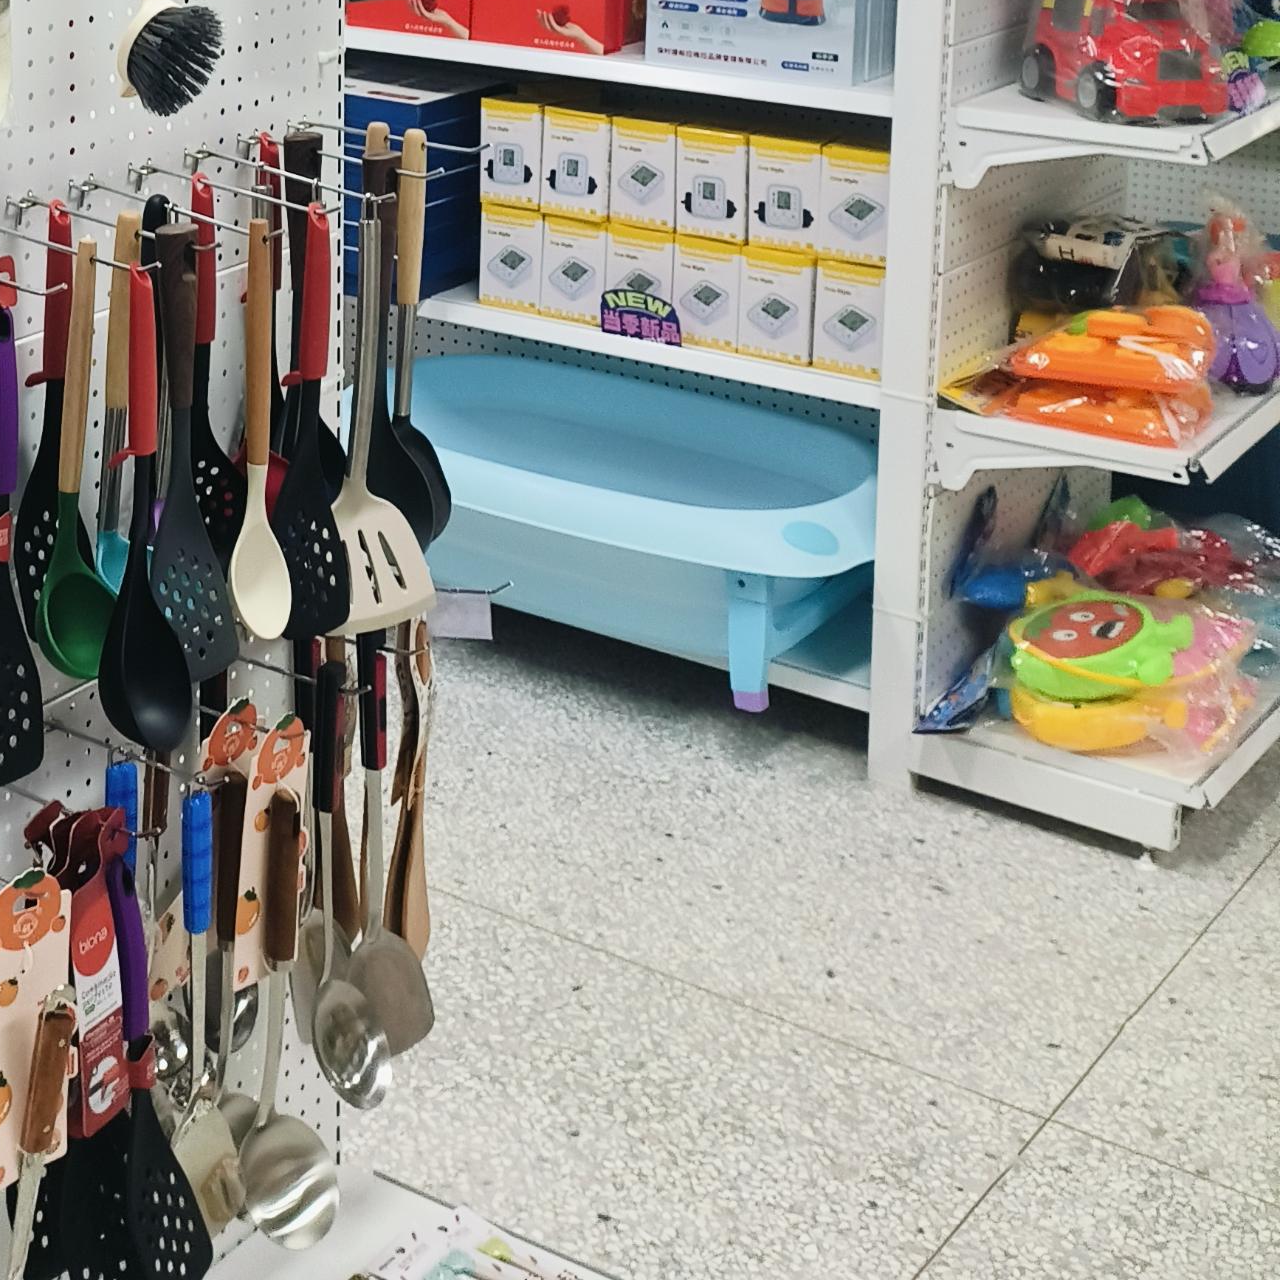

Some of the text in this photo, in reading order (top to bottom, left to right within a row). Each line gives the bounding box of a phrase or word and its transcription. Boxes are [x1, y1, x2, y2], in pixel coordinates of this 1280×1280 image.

[604, 291, 673, 318] NEW
[603, 309, 681, 344] 当季新品
[78, 926, 108, 955] biona
